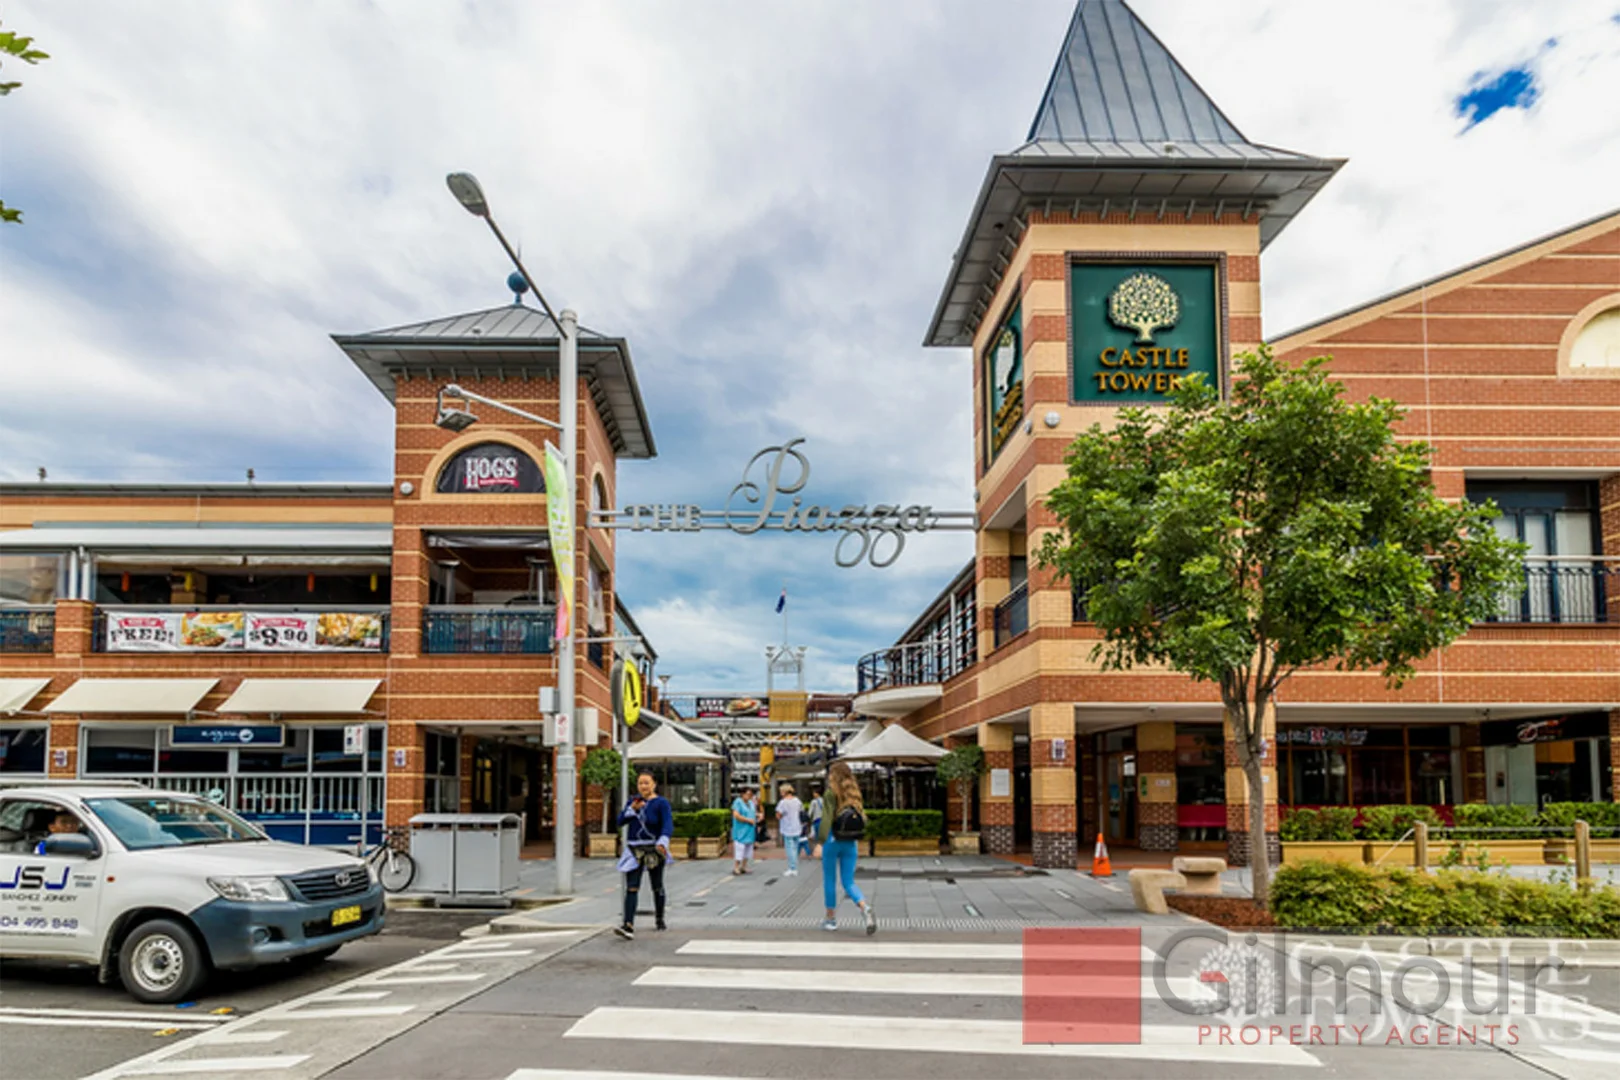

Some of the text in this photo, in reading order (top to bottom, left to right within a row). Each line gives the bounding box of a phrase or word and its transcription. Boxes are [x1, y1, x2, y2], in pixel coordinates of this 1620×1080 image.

[1100, 347, 1188, 367] CASTLE
[1094, 371, 1183, 391] TOWER
[465, 457, 518, 489] HOGS
[624, 438, 940, 568] THE Piazza
[0, 866, 70, 889] JSJ
[2, 893, 77, 902] SANCHEZ JOINERY
